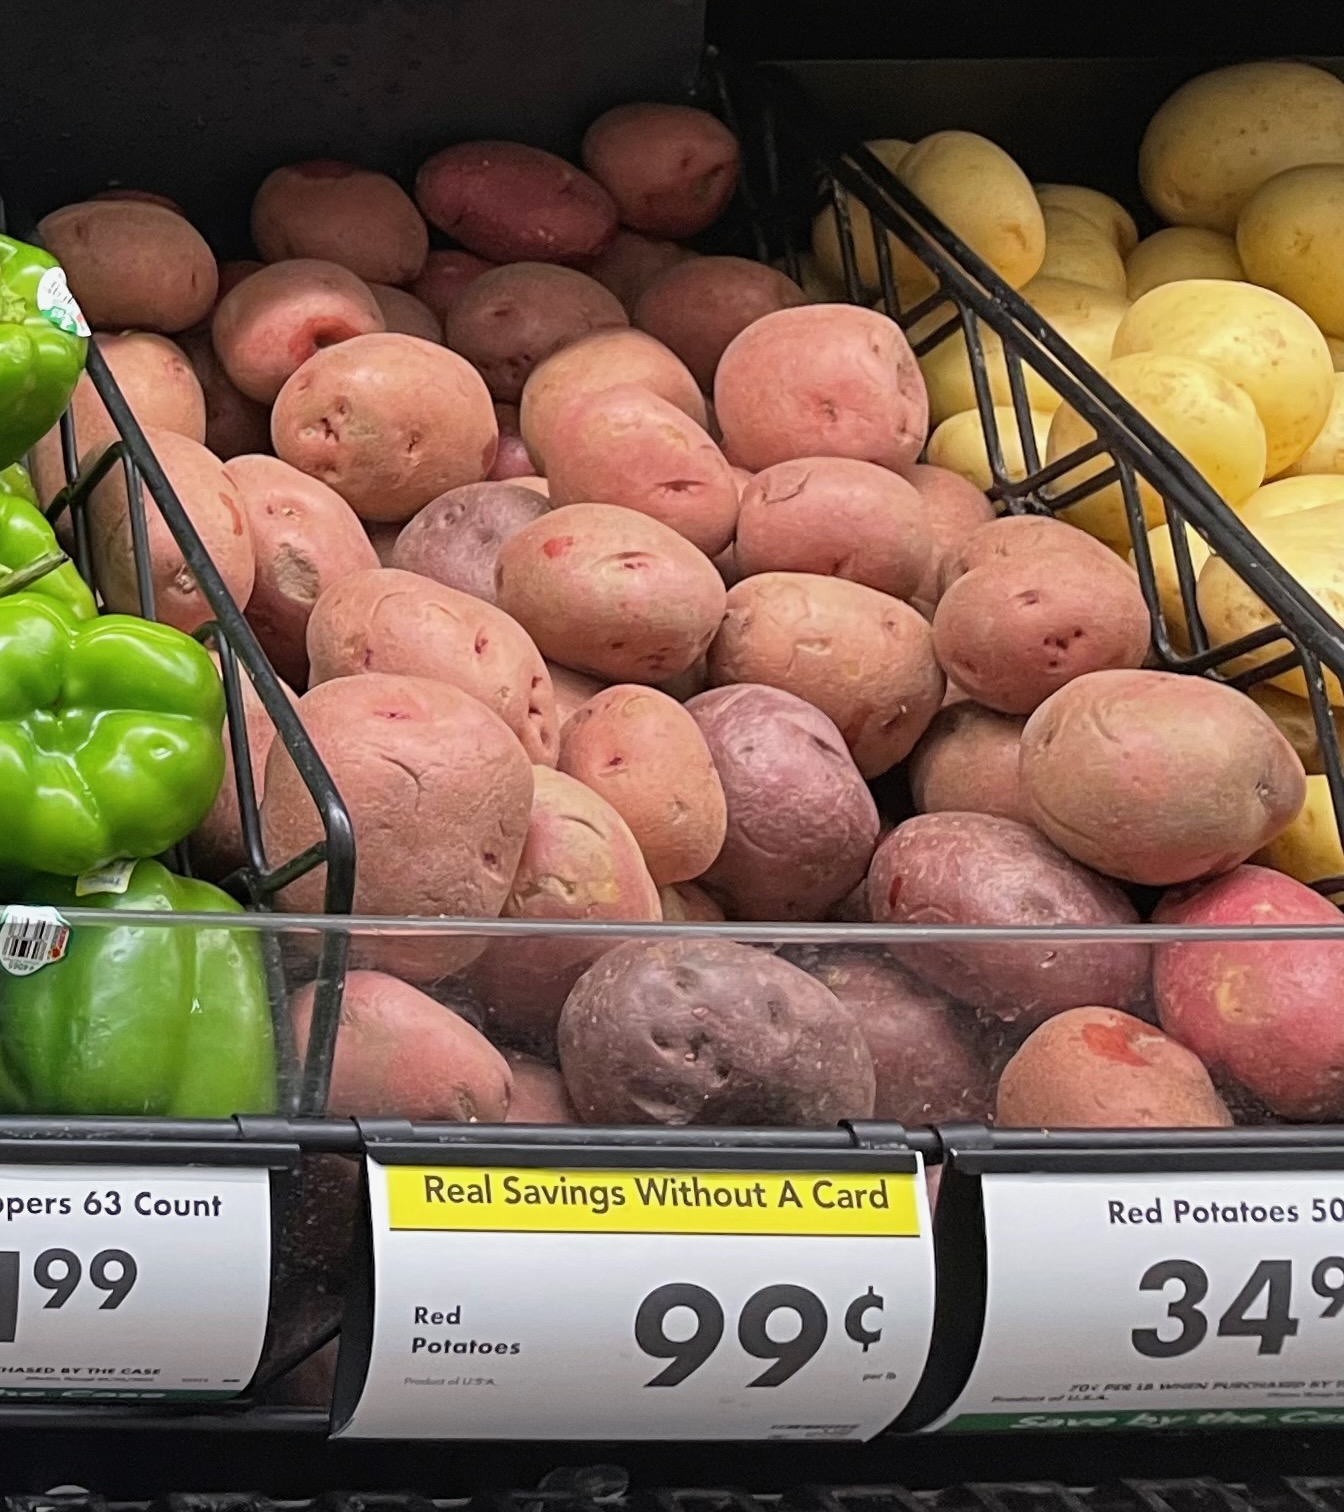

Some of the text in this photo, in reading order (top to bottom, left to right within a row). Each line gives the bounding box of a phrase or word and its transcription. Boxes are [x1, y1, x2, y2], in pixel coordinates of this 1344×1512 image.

[84, 1191, 121, 1215] 63
[135, 1192, 221, 1216] Count
[424, 1174, 889, 1214] Real Savings Without A Card
[1109, 1198, 1162, 1224] Red
[1174, 1200, 1298, 1223] Potatoes
[415, 1306, 460, 1324] Red
[412, 1338, 520, 1354] Potatoes
[635, 1283, 883, 1389] 99¢
[61, 1366, 82, 1374] BY
[122, 1367, 160, 1375] CASE
